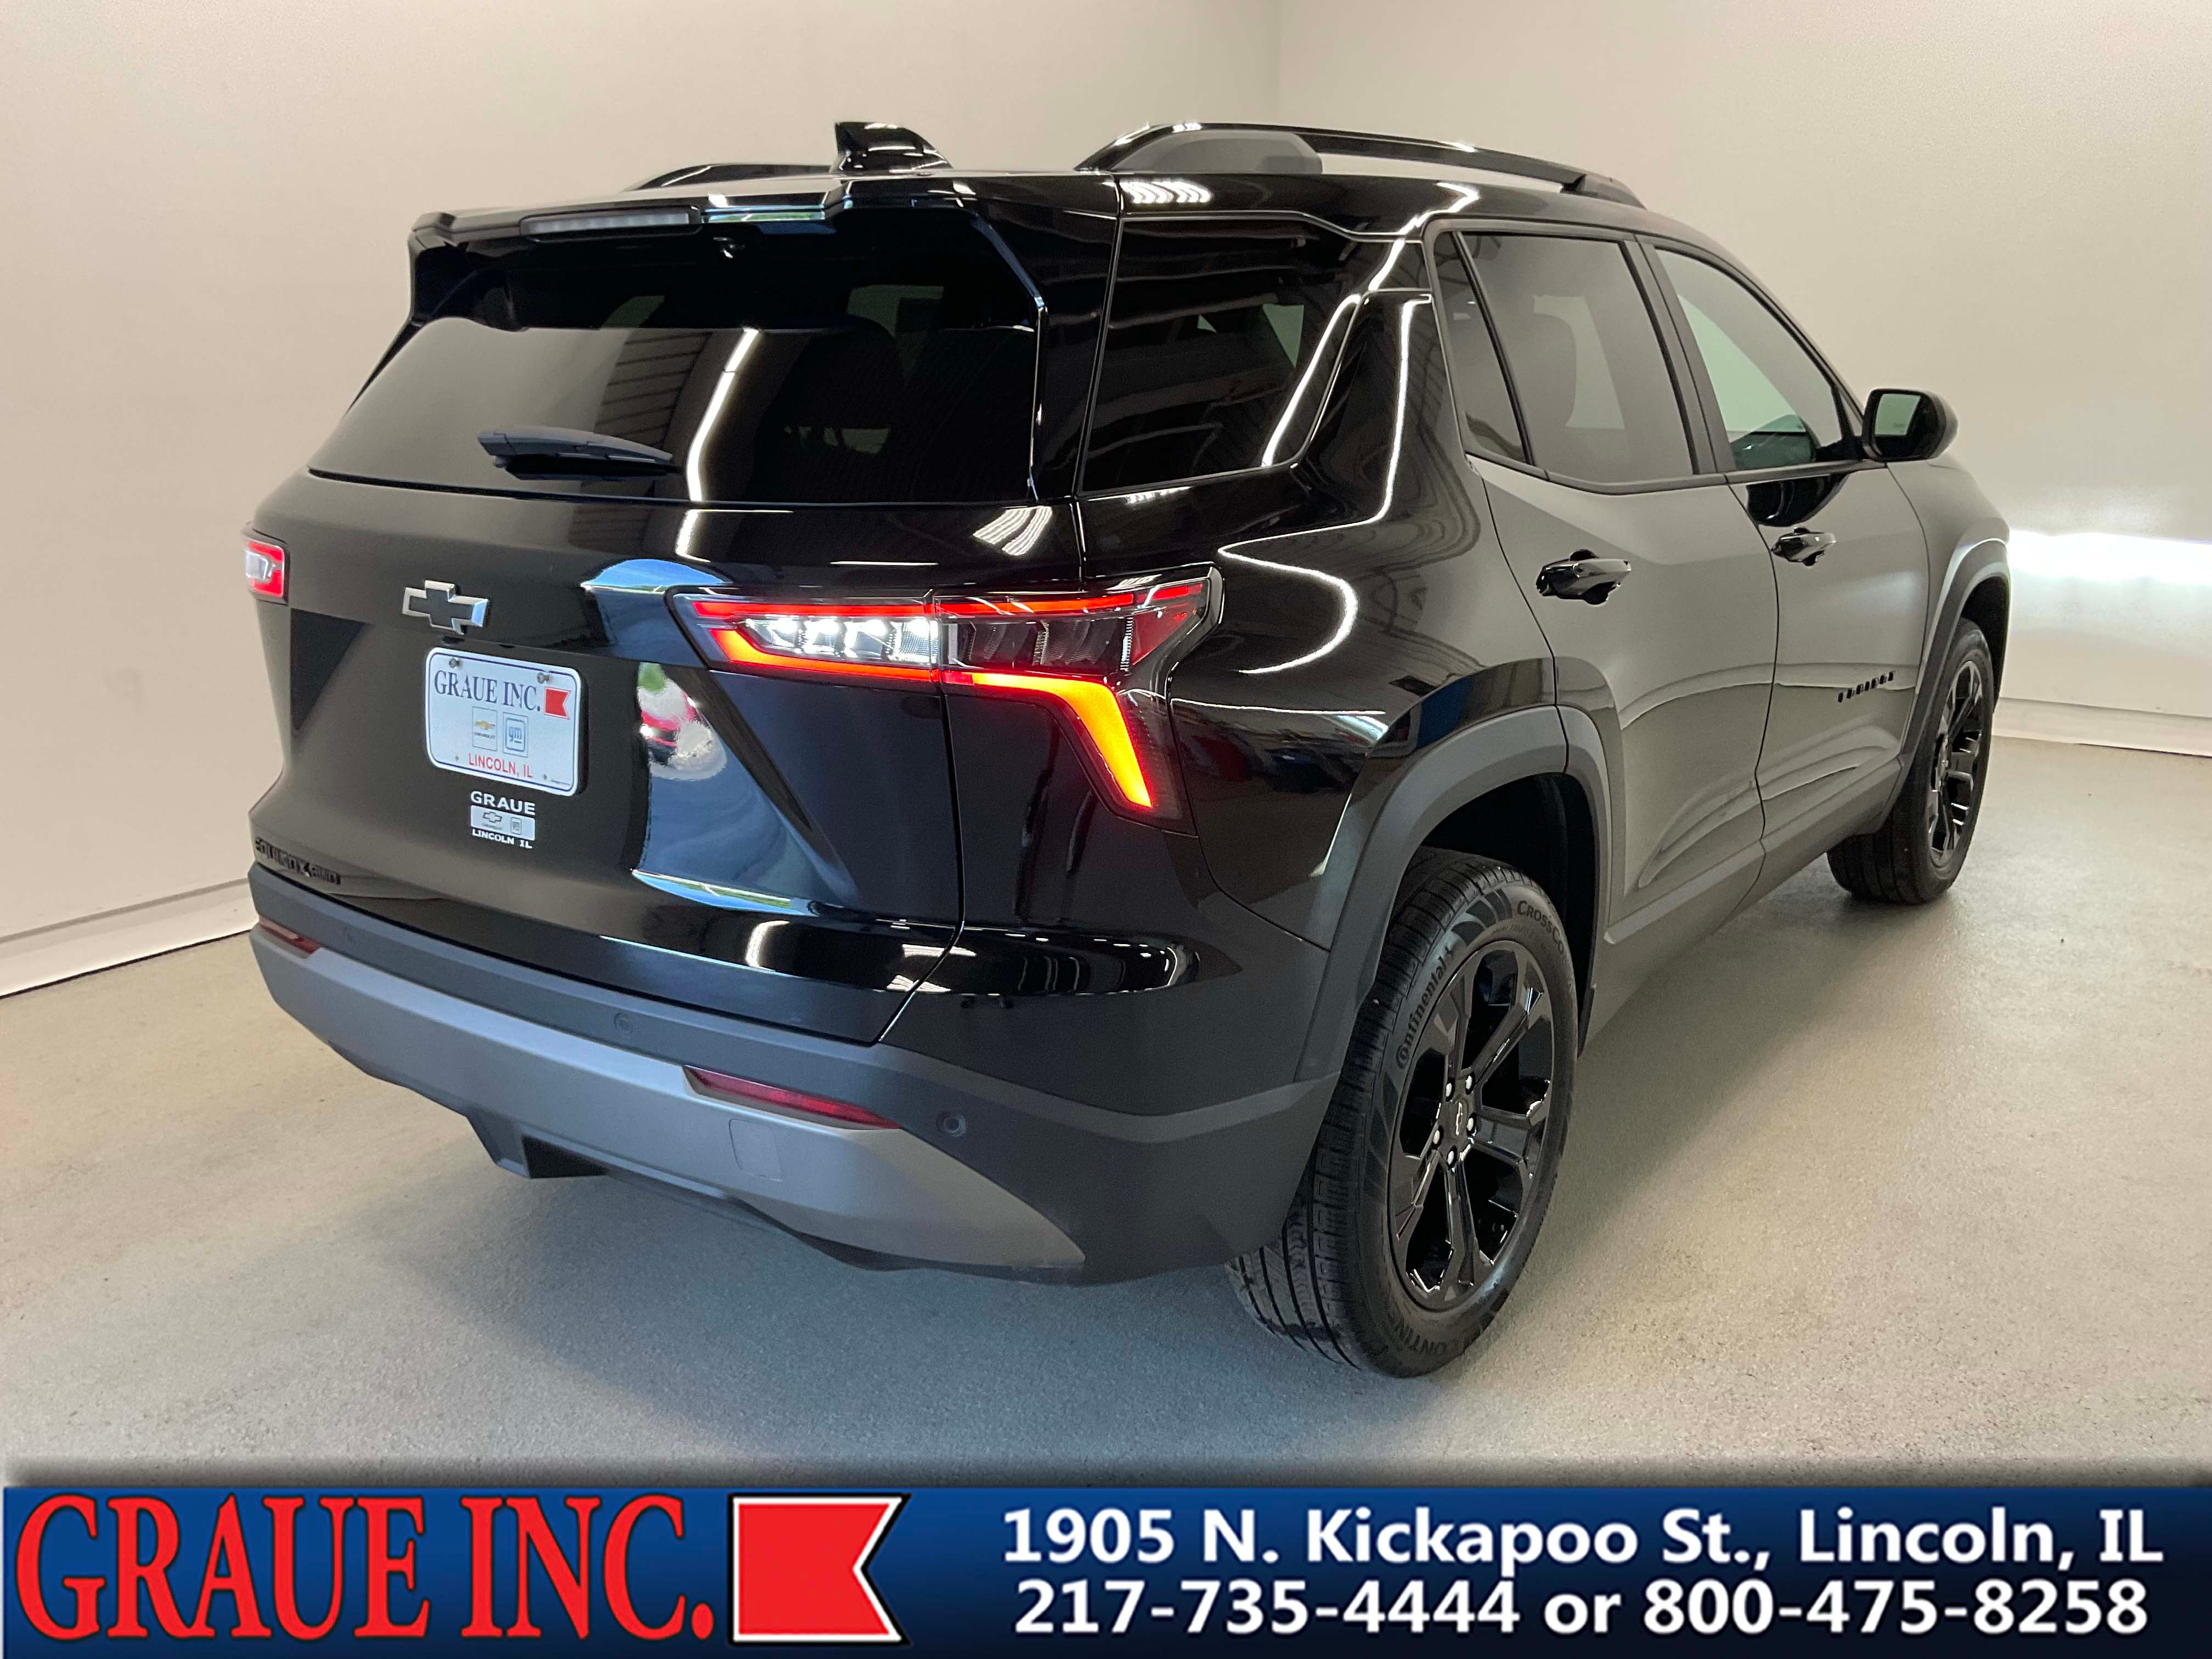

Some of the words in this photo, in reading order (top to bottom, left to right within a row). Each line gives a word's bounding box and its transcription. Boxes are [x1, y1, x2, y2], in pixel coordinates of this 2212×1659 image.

[434, 670, 498, 704] GRAUE
[503, 681, 541, 712] INC.
[469, 753, 520, 778] LINCOLN,
[523, 764, 533, 778] IL
[470, 791, 535, 816] GRAUE
[472, 828, 515, 845] LINCOLN
[520, 839, 533, 849] IL
[1395, 956, 1448, 1070] Continental
